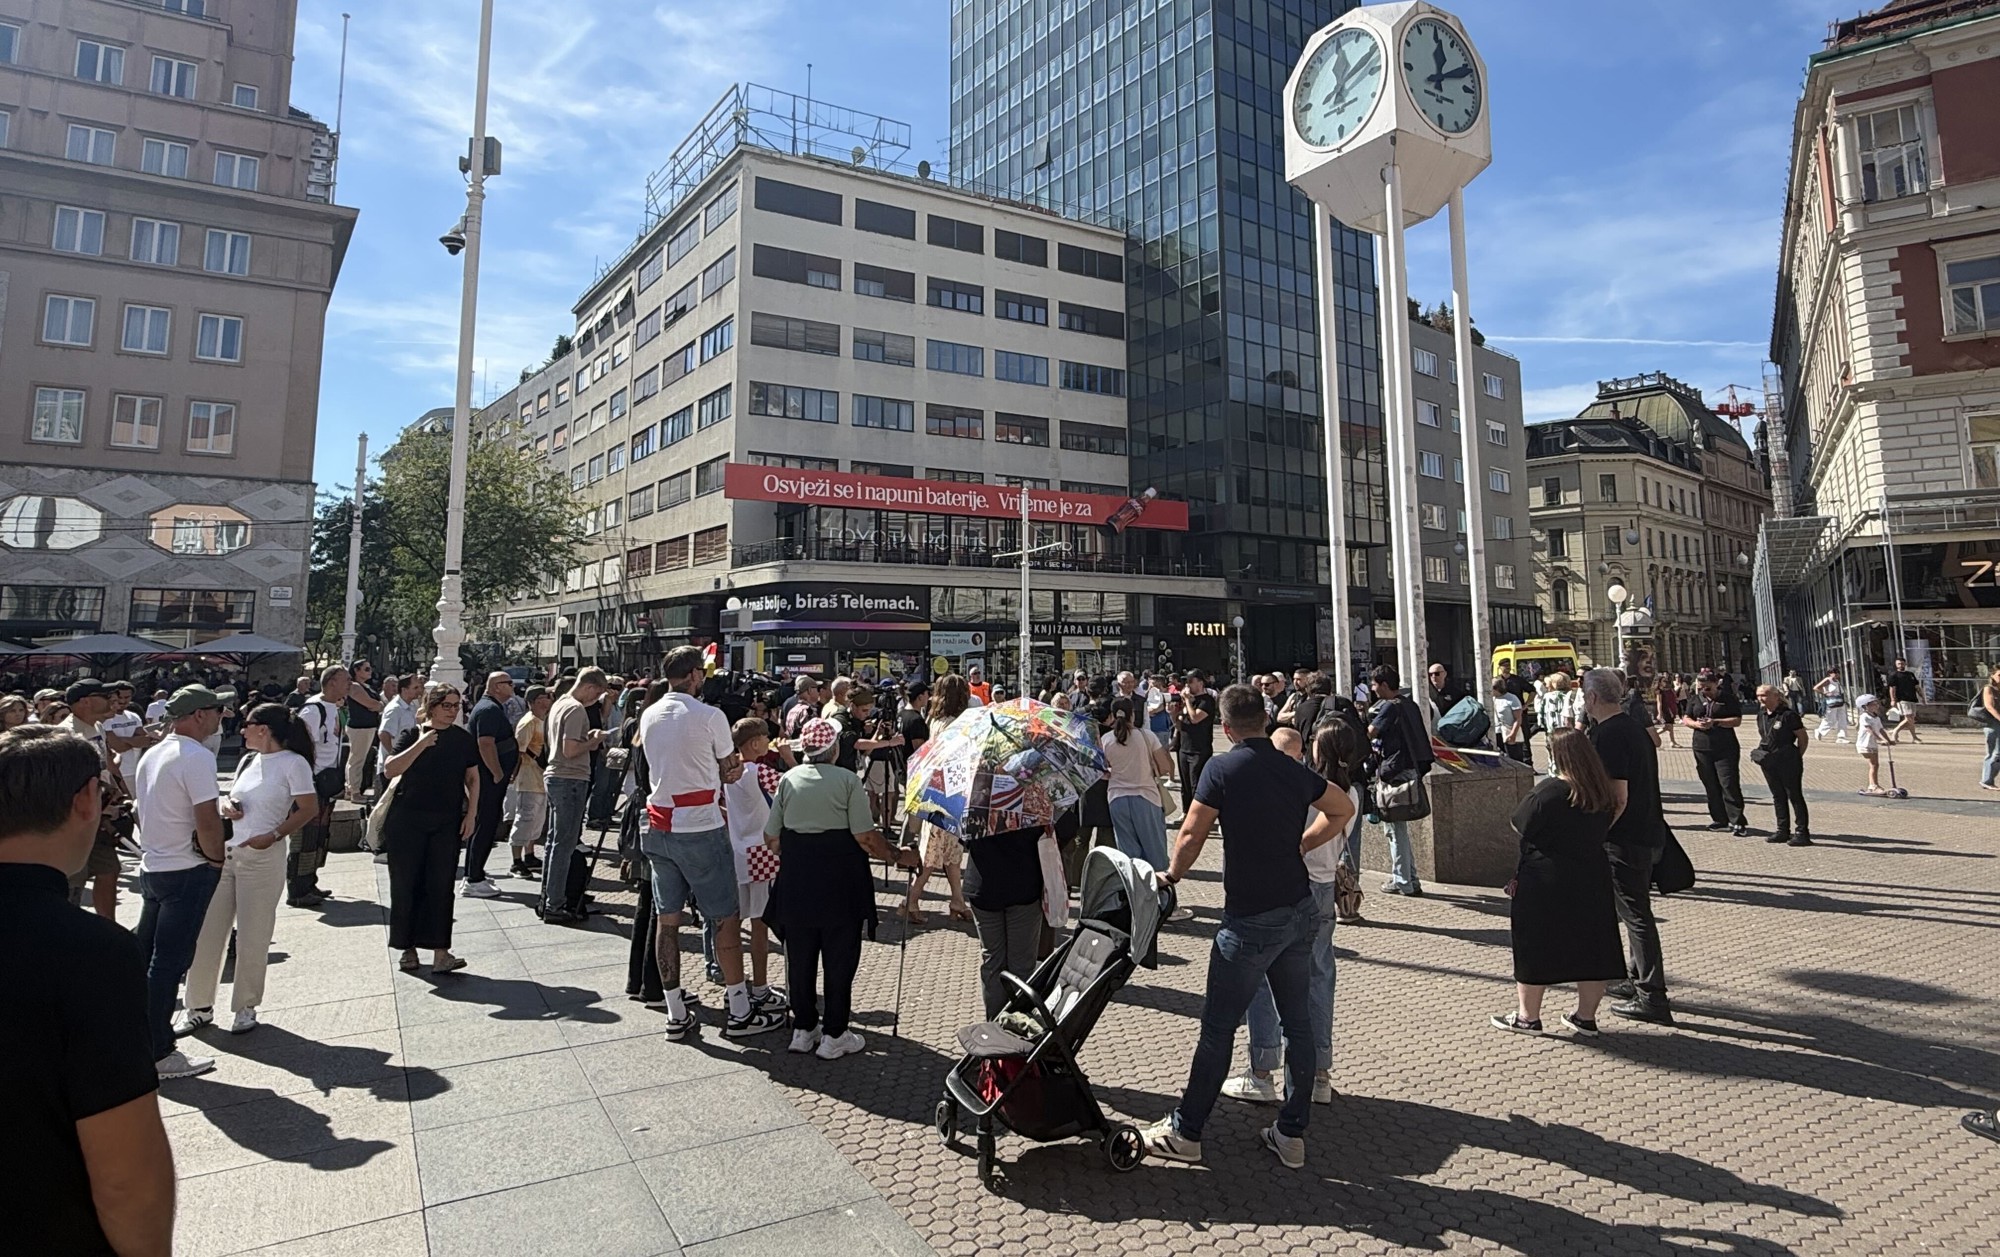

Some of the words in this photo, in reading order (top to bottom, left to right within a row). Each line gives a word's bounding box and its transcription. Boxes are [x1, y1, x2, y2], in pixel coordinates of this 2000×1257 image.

[763, 474, 830, 499] Osvježi
[833, 484, 854, 499] se
[857, 481, 862, 499] i
[865, 486, 923, 505] napuni
[926, 487, 990, 511] baterije.
[998, 492, 1058, 515] Vrieme
[1059, 497, 1073, 518] je
[1075, 502, 1092, 516] za
[764, 594, 792, 613] bolje,
[795, 593, 839, 609] biraš
[841, 593, 920, 611] Telemach.
[1034, 622, 1083, 636] KNJIŽARA
[1087, 624, 1121, 637] LJEVAK
[1186, 622, 1226, 636] PELATI
[779, 634, 821, 644] telemach
